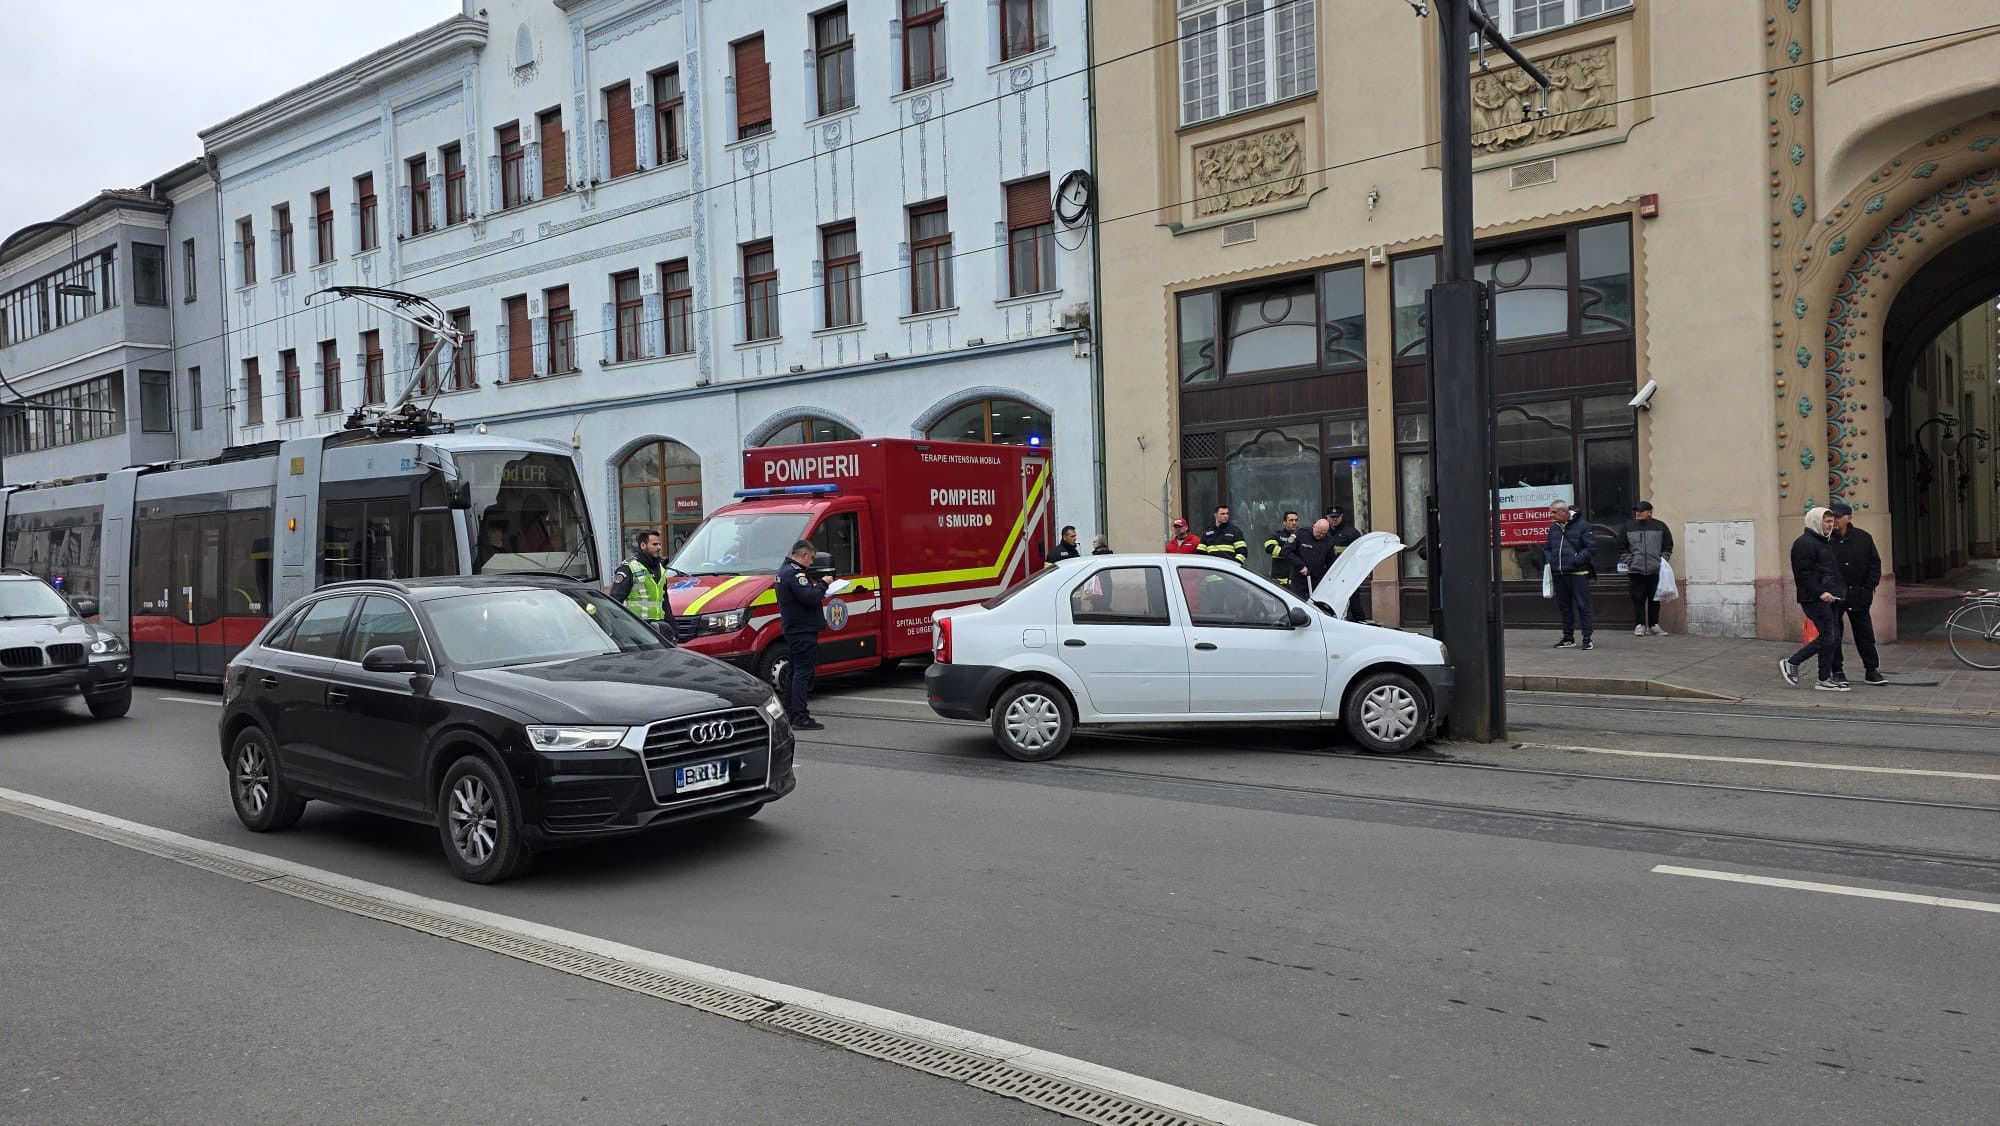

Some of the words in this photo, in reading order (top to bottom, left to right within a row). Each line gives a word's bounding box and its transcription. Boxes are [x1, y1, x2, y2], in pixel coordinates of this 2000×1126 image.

[920, 453, 948, 463] TERAPIE
[948, 455, 979, 465] INTENSIVA
[979, 456, 1001, 465] MOBILA
[494, 464, 519, 482] Pod
[522, 464, 546, 482] CFR
[764, 453, 860, 483] POMPIERII
[930, 488, 996, 506] POMPIERII
[946, 514, 984, 528] SMURD
[1513, 512, 1524, 520] DE
[896, 617, 923, 628] SPITALUL
[907, 628, 916, 636] DE
